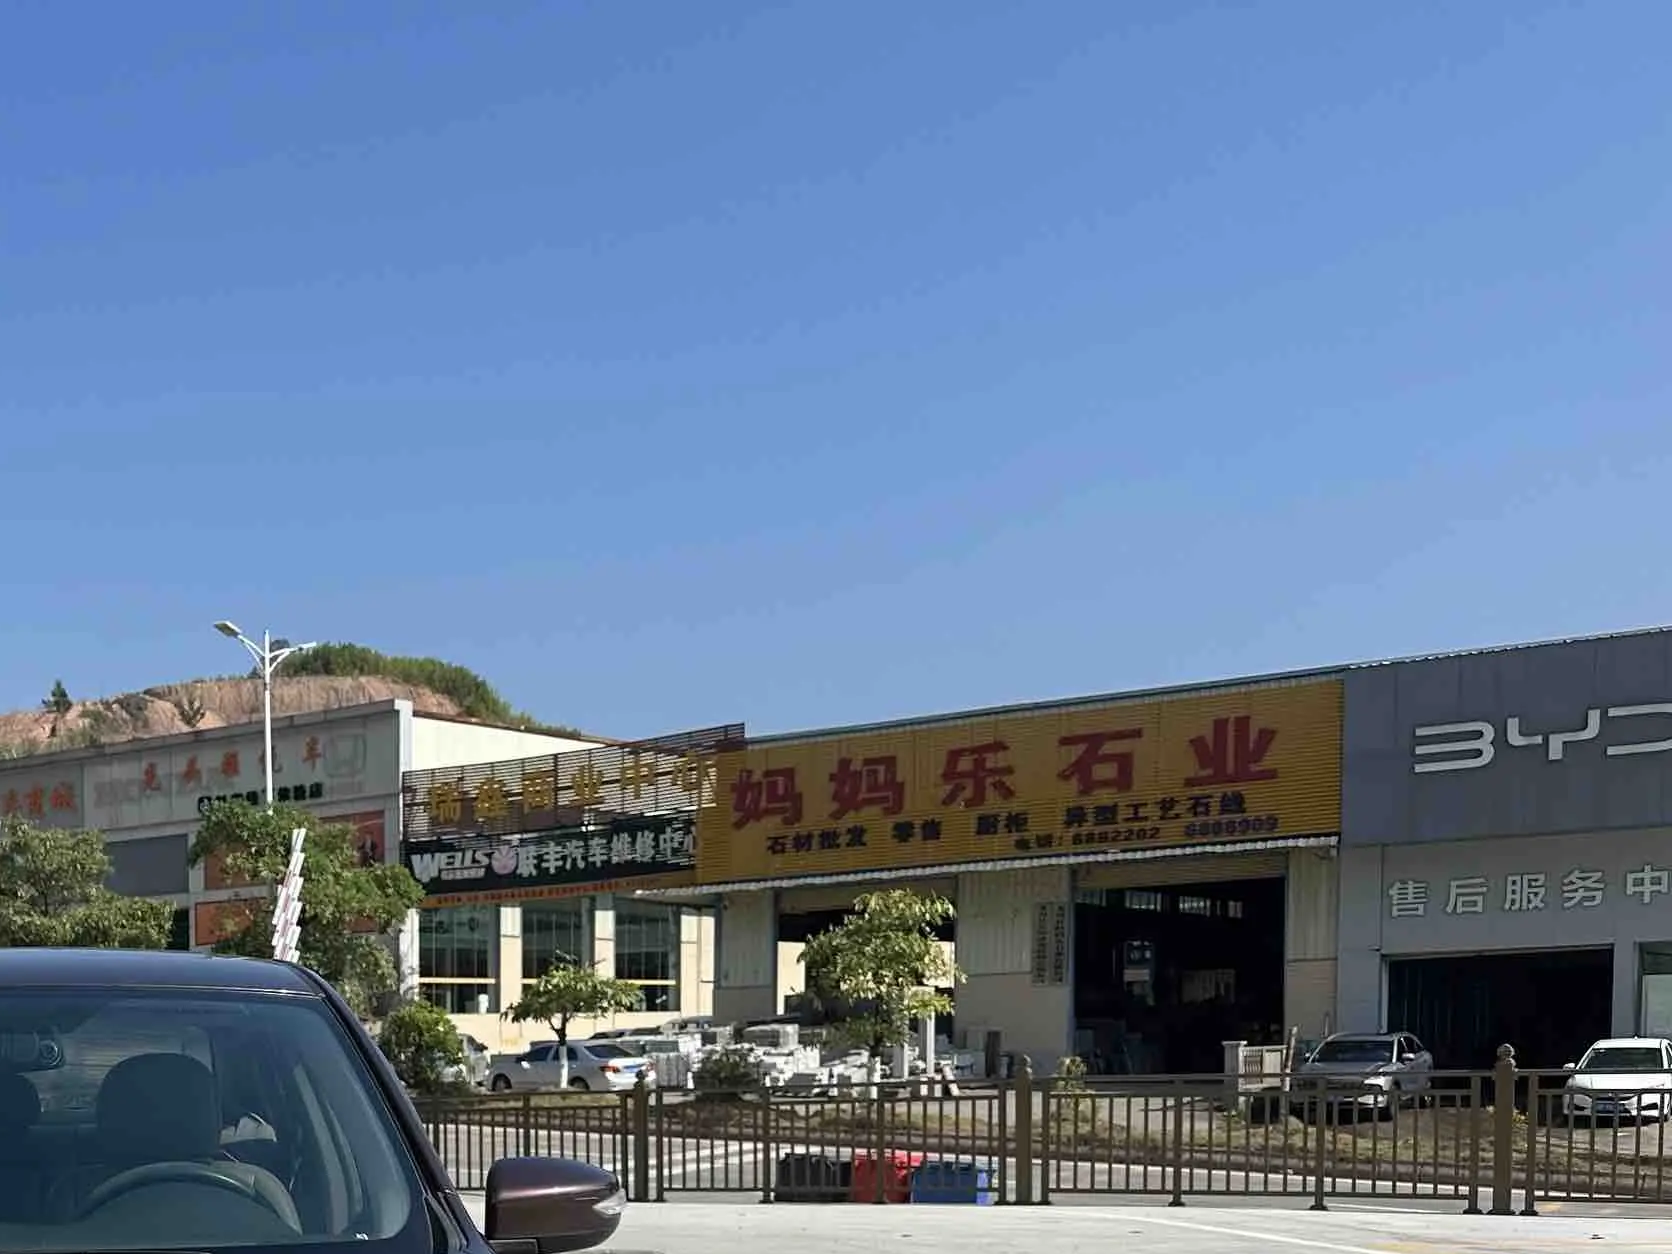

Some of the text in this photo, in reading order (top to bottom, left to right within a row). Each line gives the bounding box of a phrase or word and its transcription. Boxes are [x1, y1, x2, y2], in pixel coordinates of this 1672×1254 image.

[731, 714, 1279, 831] 妈妈乐石业
[765, 824, 867, 855] 石材批发
[892, 818, 941, 843] 零售
[1388, 864, 1670, 918] 售后服务中
